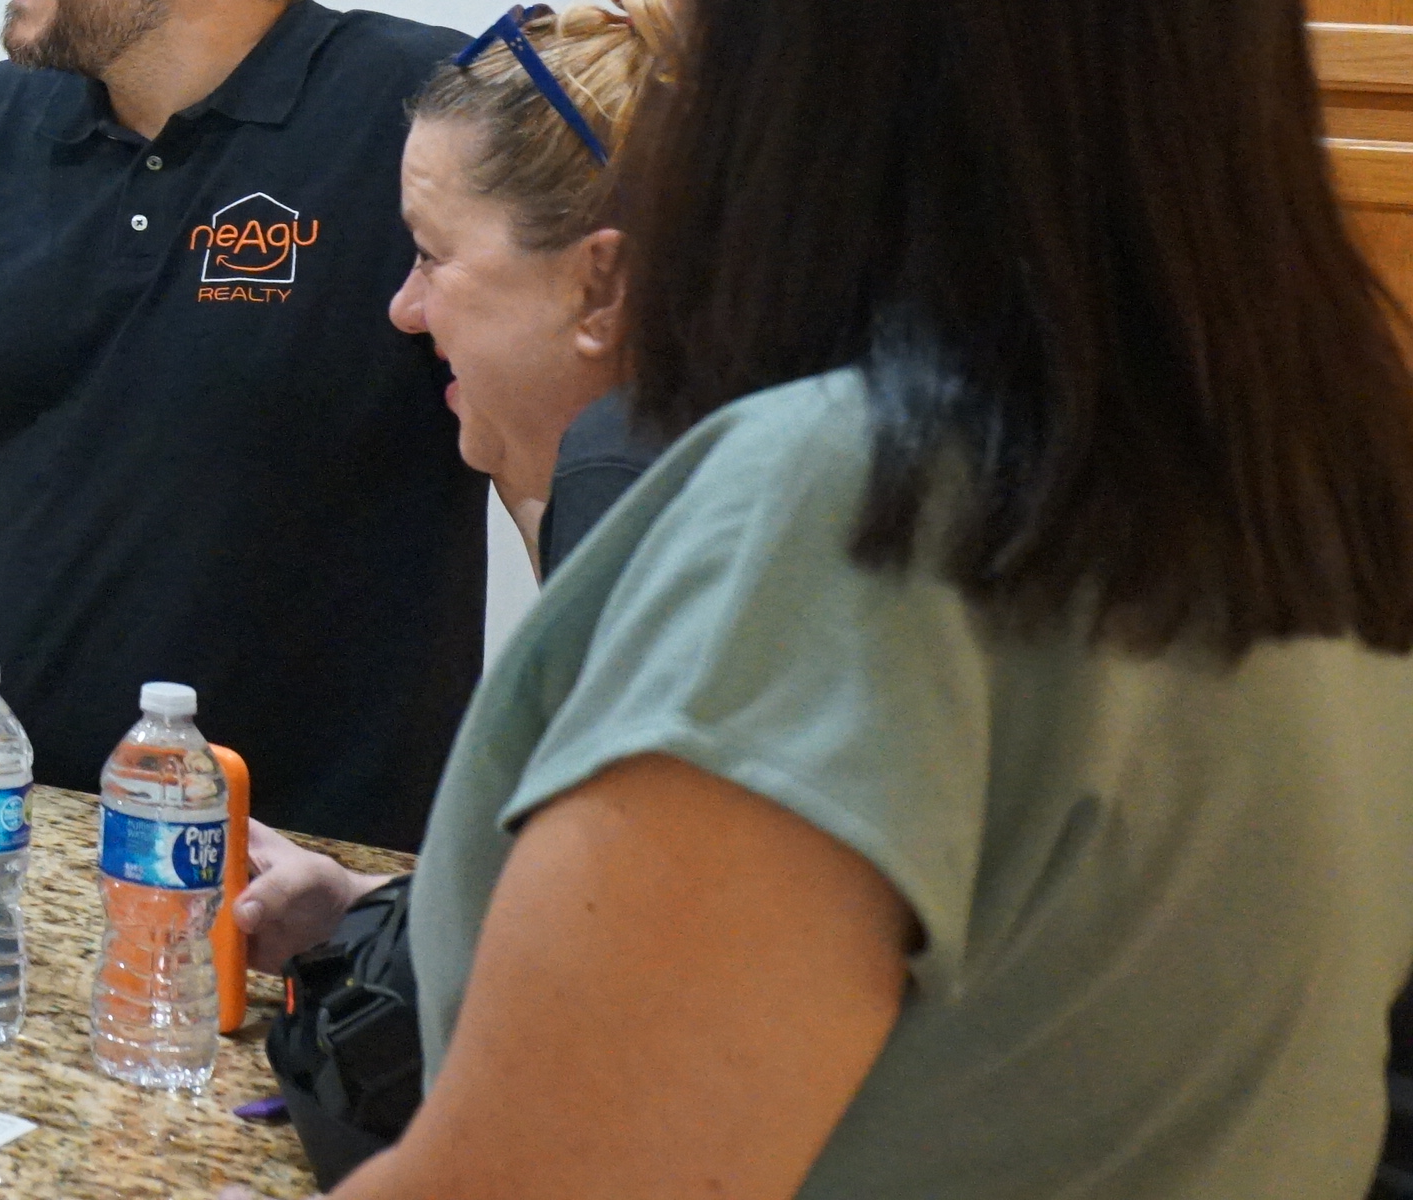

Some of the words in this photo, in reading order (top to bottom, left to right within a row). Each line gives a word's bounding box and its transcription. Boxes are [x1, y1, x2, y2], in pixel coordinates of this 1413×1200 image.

[198, 286, 292, 303] REALTY
[185, 826, 222, 846] Pure
[189, 845, 218, 869] Life
